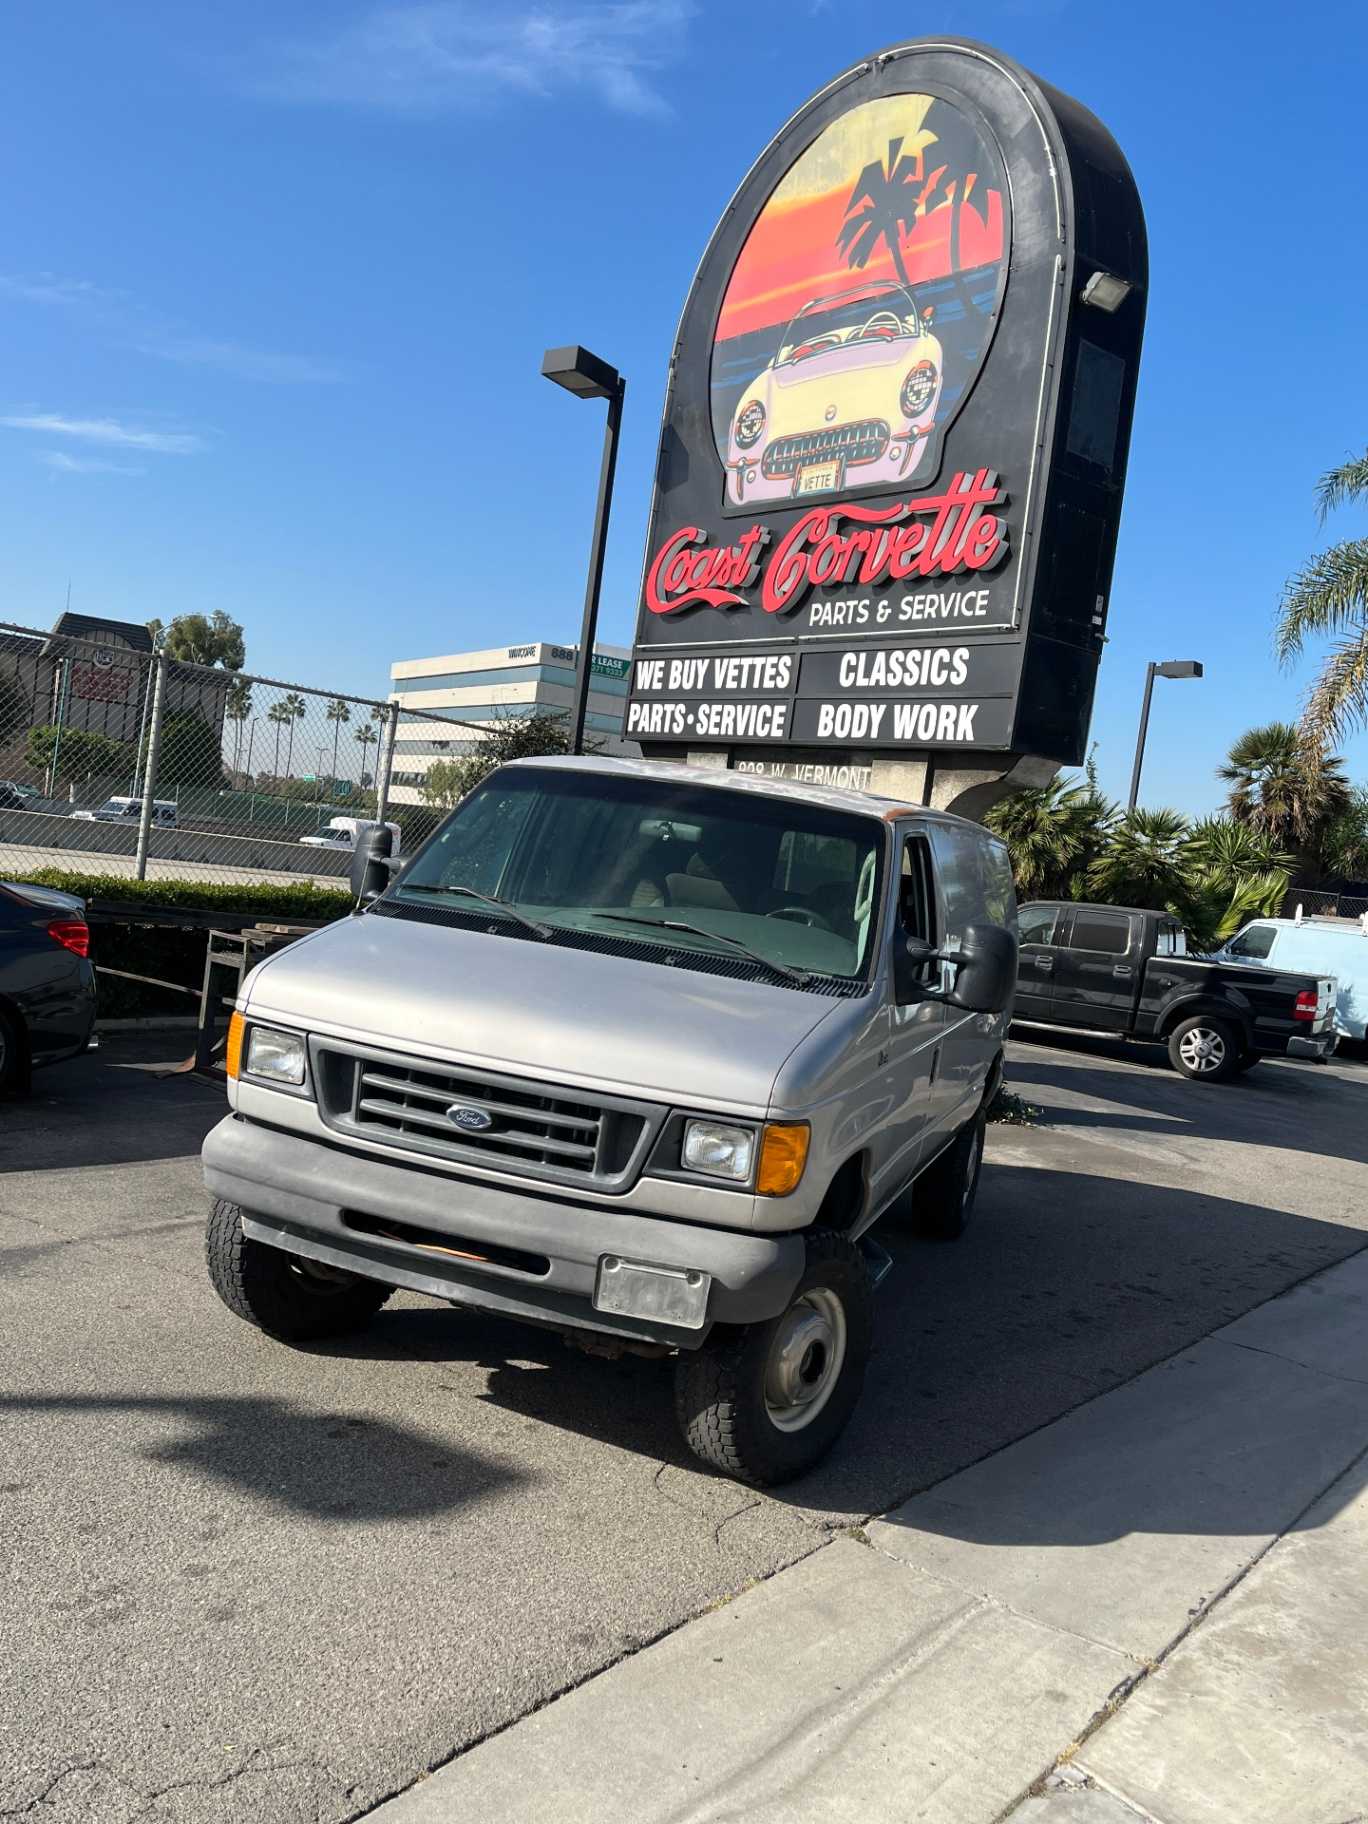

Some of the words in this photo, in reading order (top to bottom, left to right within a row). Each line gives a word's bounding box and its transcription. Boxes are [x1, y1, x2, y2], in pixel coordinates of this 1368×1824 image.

[803, 473, 832, 491] VETTE
[646, 525, 764, 614] Coast
[762, 468, 1003, 613] Corvette
[809, 599, 870, 626] PARTS
[876, 600, 892, 623] &
[898, 590, 989, 621] SERVICE
[551, 647, 573, 660] 888
[598, 656, 623, 669] LEASE
[839, 648, 969, 687] CLASSICS
[637, 660, 665, 690] WE
[668, 659, 710, 690] BUY
[714, 655, 792, 689] VETTES
[817, 704, 886, 738] BODY
[894, 704, 979, 741] WORK
[795, 764, 871, 790] VERMONT
[456, 1110, 480, 1125] Ford
